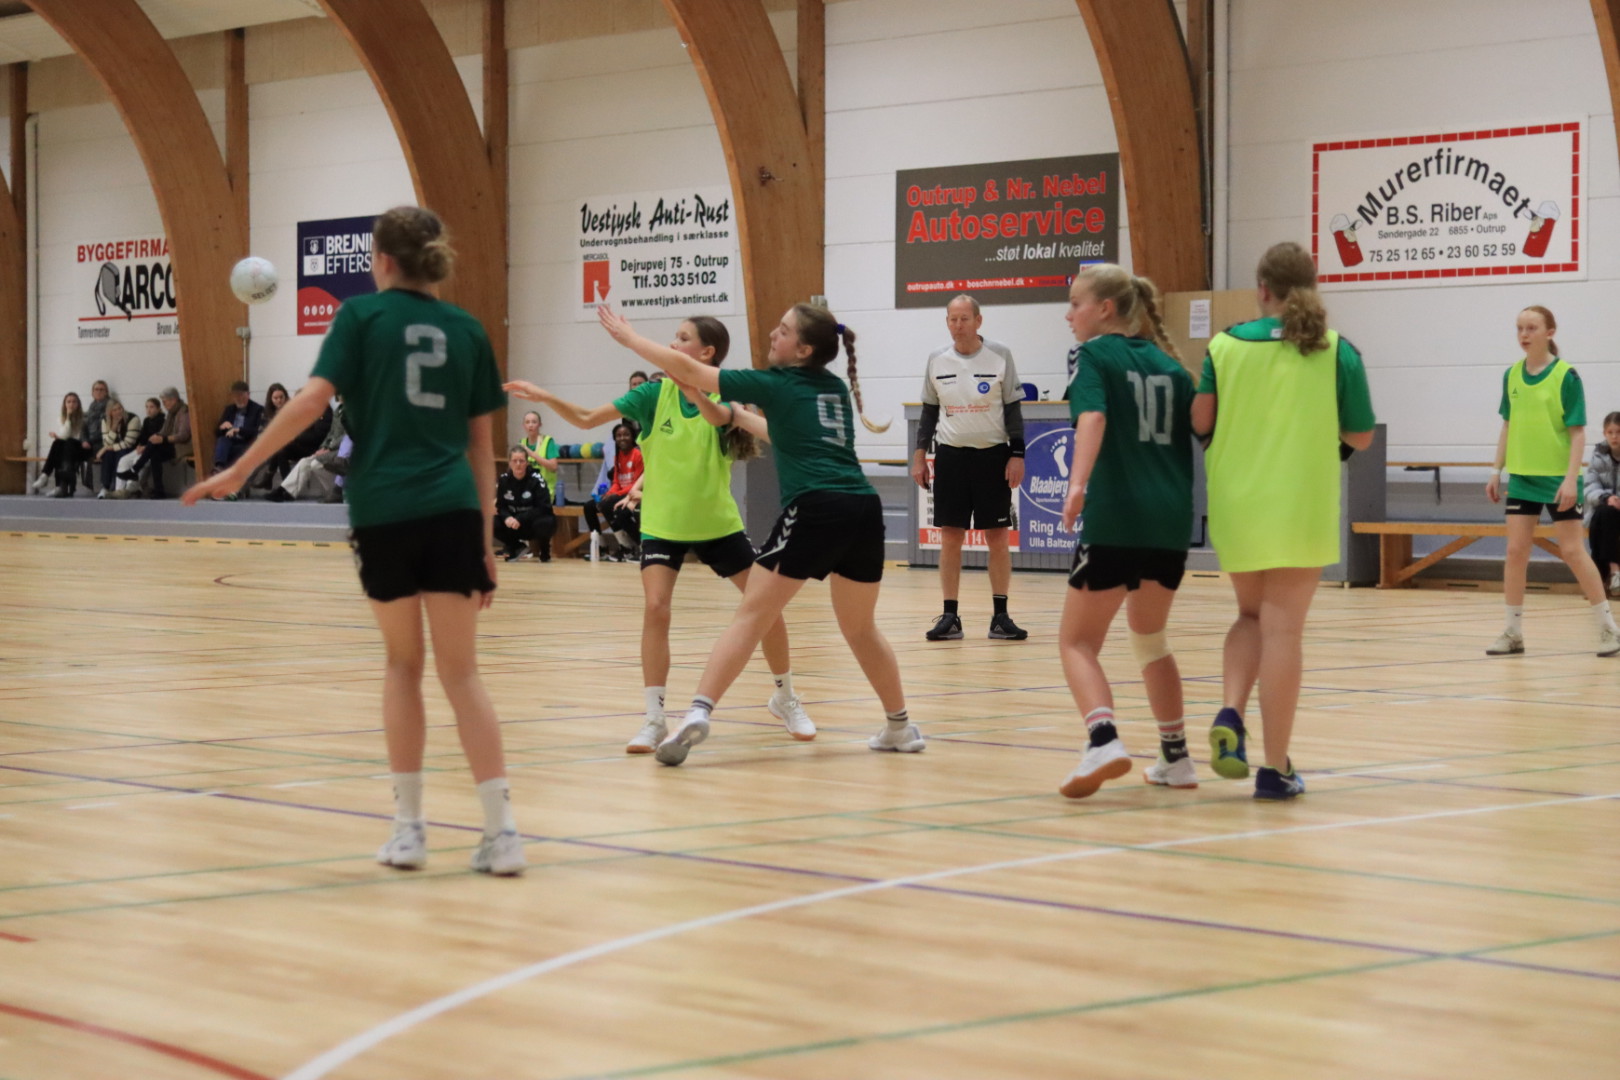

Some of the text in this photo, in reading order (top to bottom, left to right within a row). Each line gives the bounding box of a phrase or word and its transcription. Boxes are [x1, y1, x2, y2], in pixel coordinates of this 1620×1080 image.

[907, 172, 1107, 208] Outrup & Nr. Nebel
[1357, 147, 1531, 225] Murerfirmaet
[580, 194, 729, 237] Vestjysk Anti-Rust
[906, 201, 1105, 243] Autoservice
[1386, 203, 1498, 225] B.S. Riber Aps
[580, 230, 729, 248] Undervognsbehandling i særklasse
[1378, 224, 1506, 240] Søndergade 22 6855 Outrup
[77, 238, 169, 263] BYGGEFIRMA
[1023, 242, 1057, 260] lokal
[1059, 240, 1105, 258] kvalitet
[1369, 243, 1516, 262] 75 25 12 65 23 60 52 59
[326, 253, 372, 275] EFTERS
[621, 254, 729, 273] Dejrupvej 75 Outrup
[633, 275, 652, 289] Tlf.
[621, 292, 729, 307] www.vestjysk-antirust.dk
[405, 323, 447, 409] 2
[1126, 370, 1174, 445] 10
[816, 393, 847, 447] 9
[1030, 476, 1069, 497] Blaabjerg
[1029, 520, 1054, 536] Ring
[1029, 537, 1045, 547] Ulla
[1047, 537, 1075, 548] Baltzer
